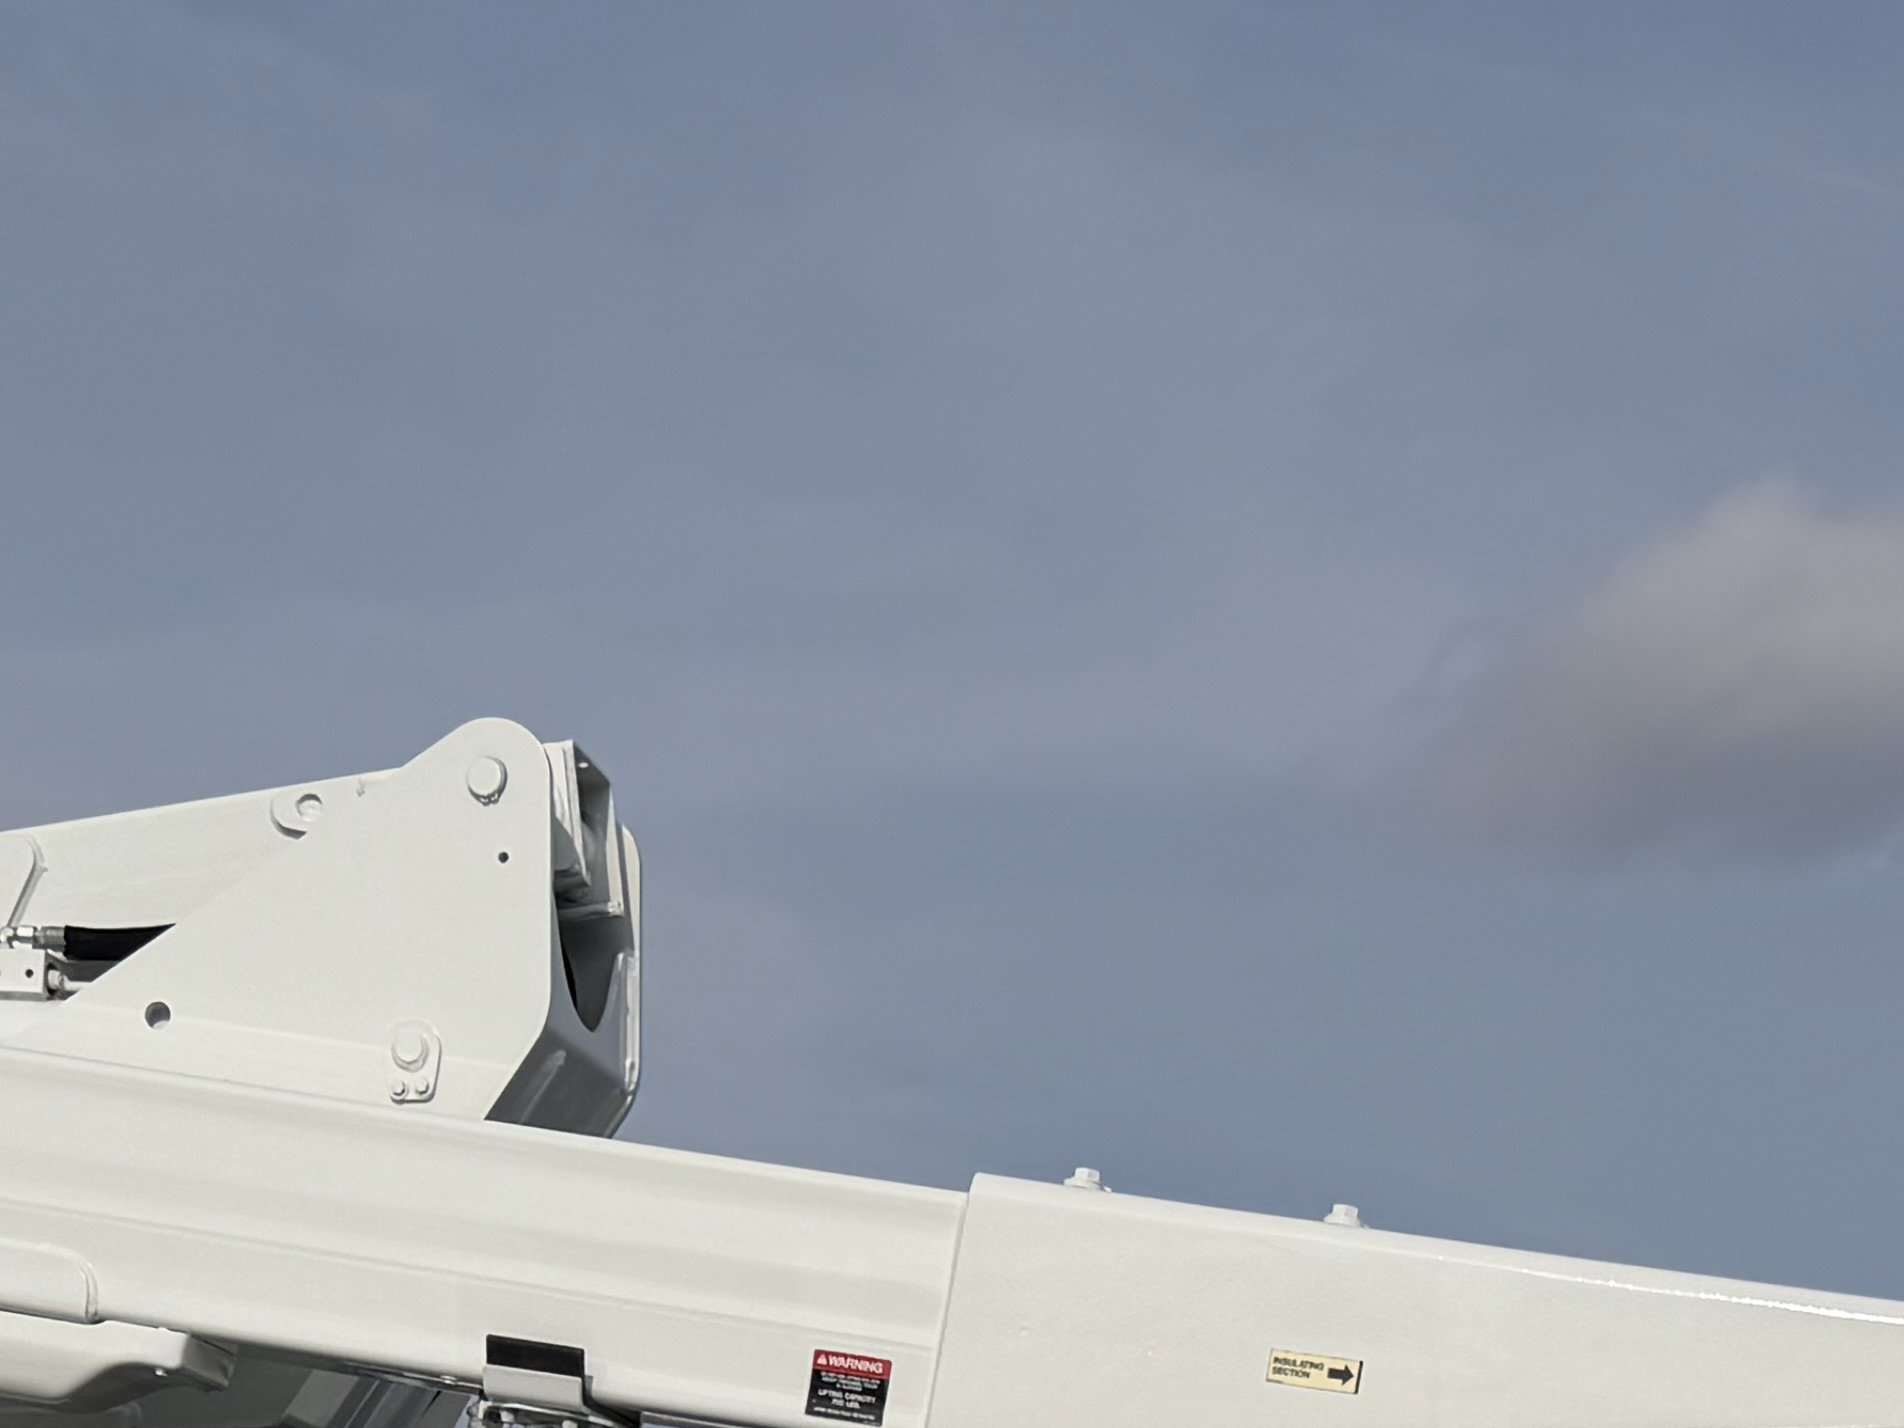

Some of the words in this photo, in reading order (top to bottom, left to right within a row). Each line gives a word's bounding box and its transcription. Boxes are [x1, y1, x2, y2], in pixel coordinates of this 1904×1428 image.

[828, 1354, 883, 1374] WARNING
[1273, 1356, 1325, 1371] INSULATING
[1272, 1366, 1311, 1379] SECTION
